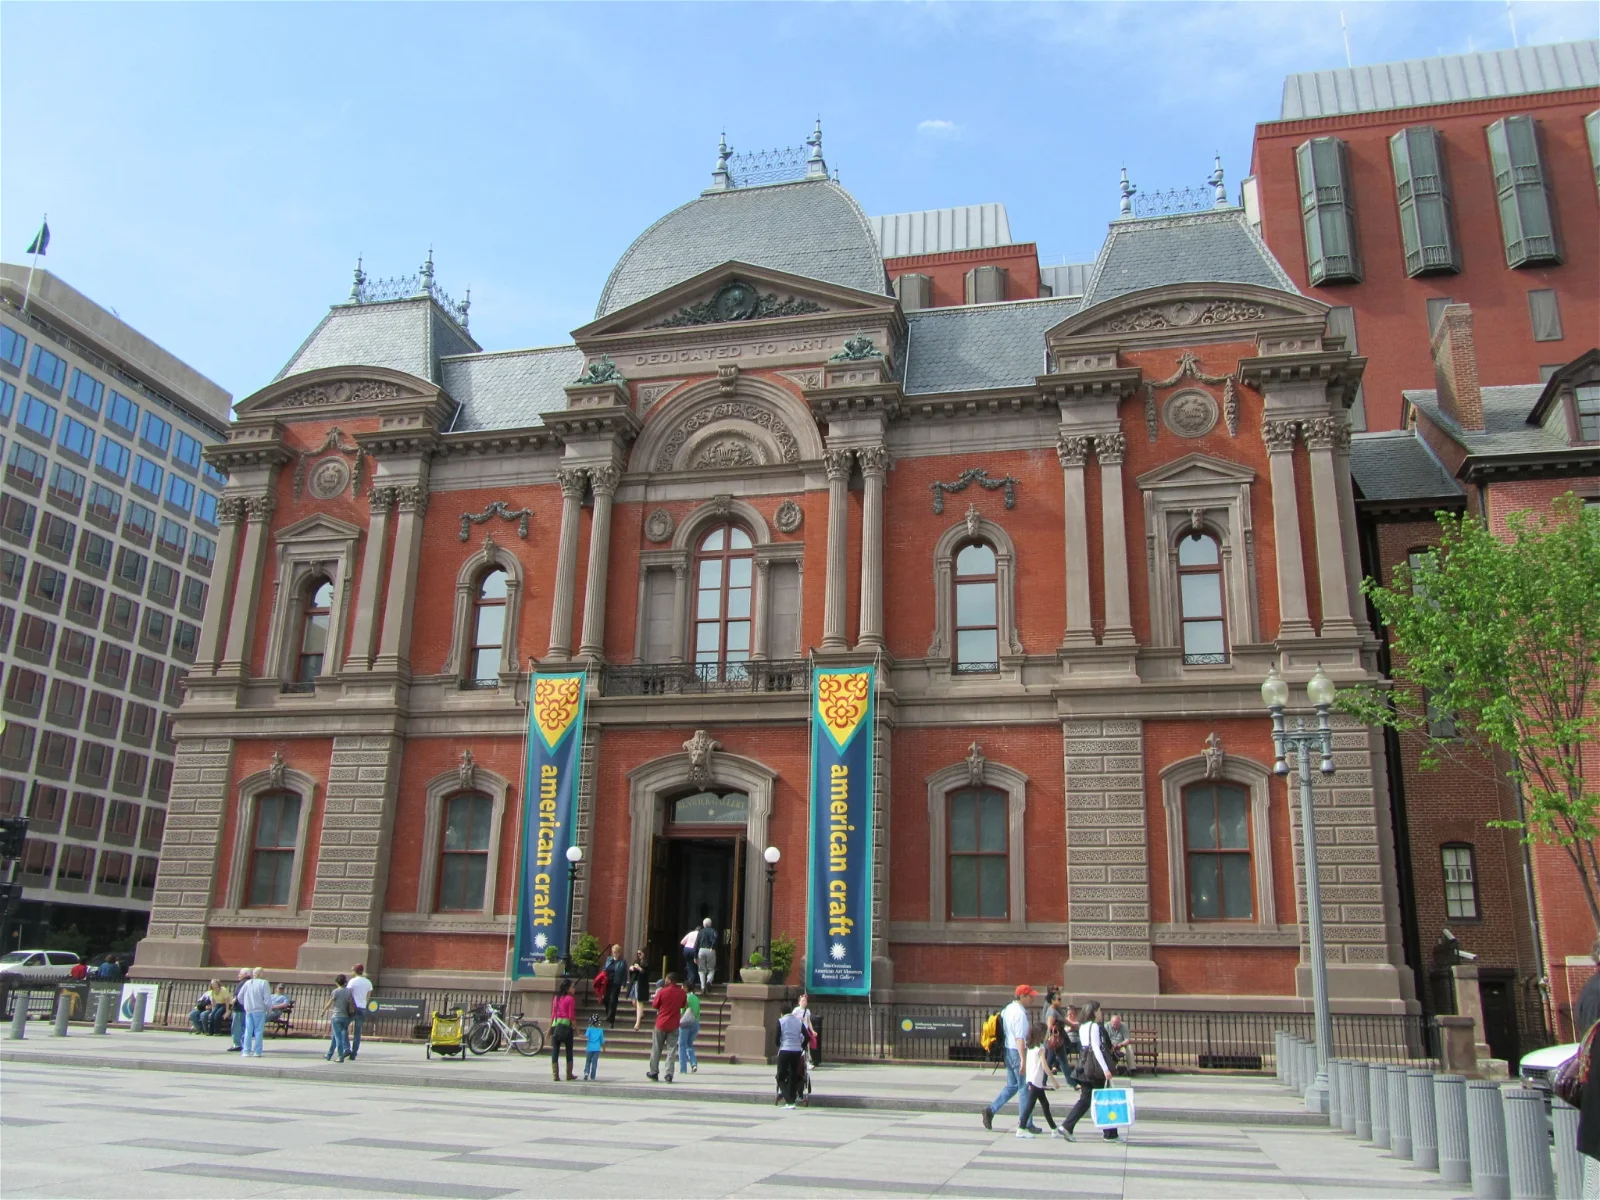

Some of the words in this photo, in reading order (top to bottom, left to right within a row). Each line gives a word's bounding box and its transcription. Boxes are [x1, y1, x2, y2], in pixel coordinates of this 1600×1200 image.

[635, 346, 742, 366] DEDICATED
[753, 342, 777, 355] TO
[788, 337, 832, 353] ART.
[536, 765, 560, 866] american
[829, 764, 855, 872] american
[533, 873, 556, 926] craft
[829, 878, 855, 937] craft
